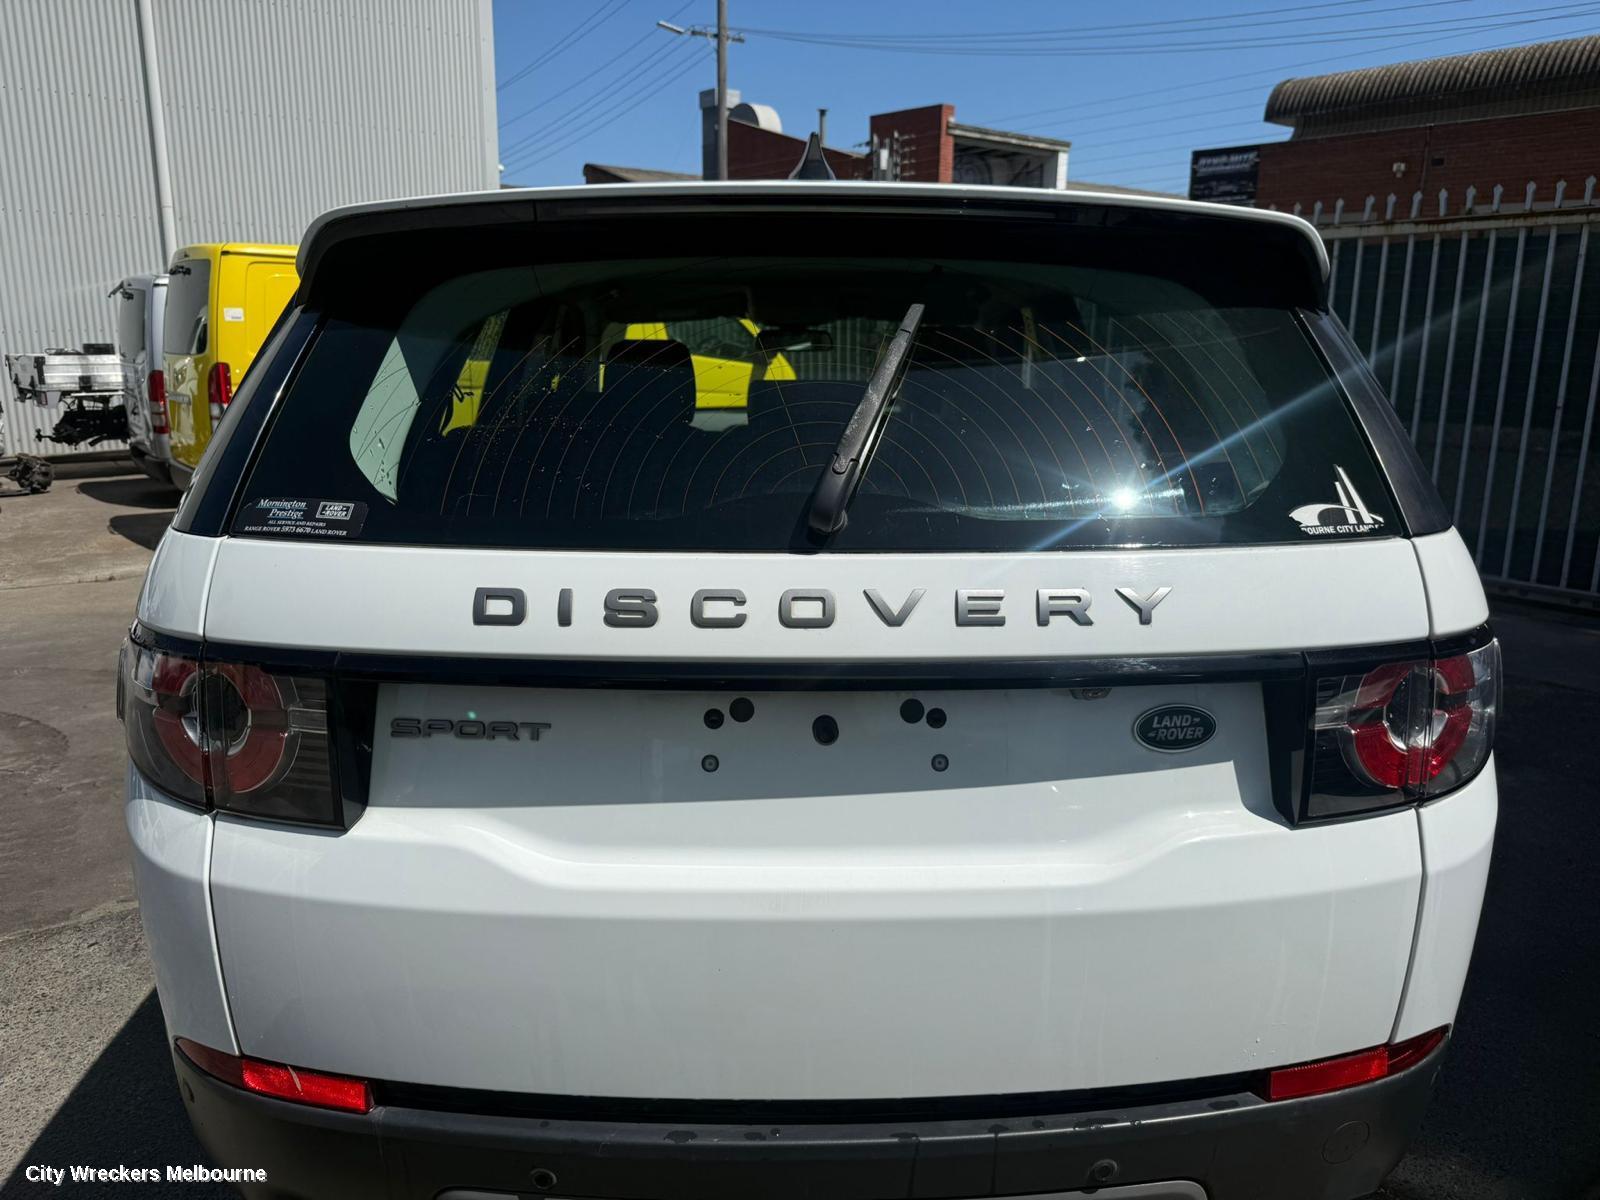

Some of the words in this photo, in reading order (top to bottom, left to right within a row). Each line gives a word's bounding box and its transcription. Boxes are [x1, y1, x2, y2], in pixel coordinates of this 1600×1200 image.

[257, 499, 307, 510] Mornington
[269, 509, 304, 519] Prestige
[1336, 524, 1355, 533] CITY
[473, 586, 1174, 628] DISCOVERY
[390, 718, 552, 741] SPORT
